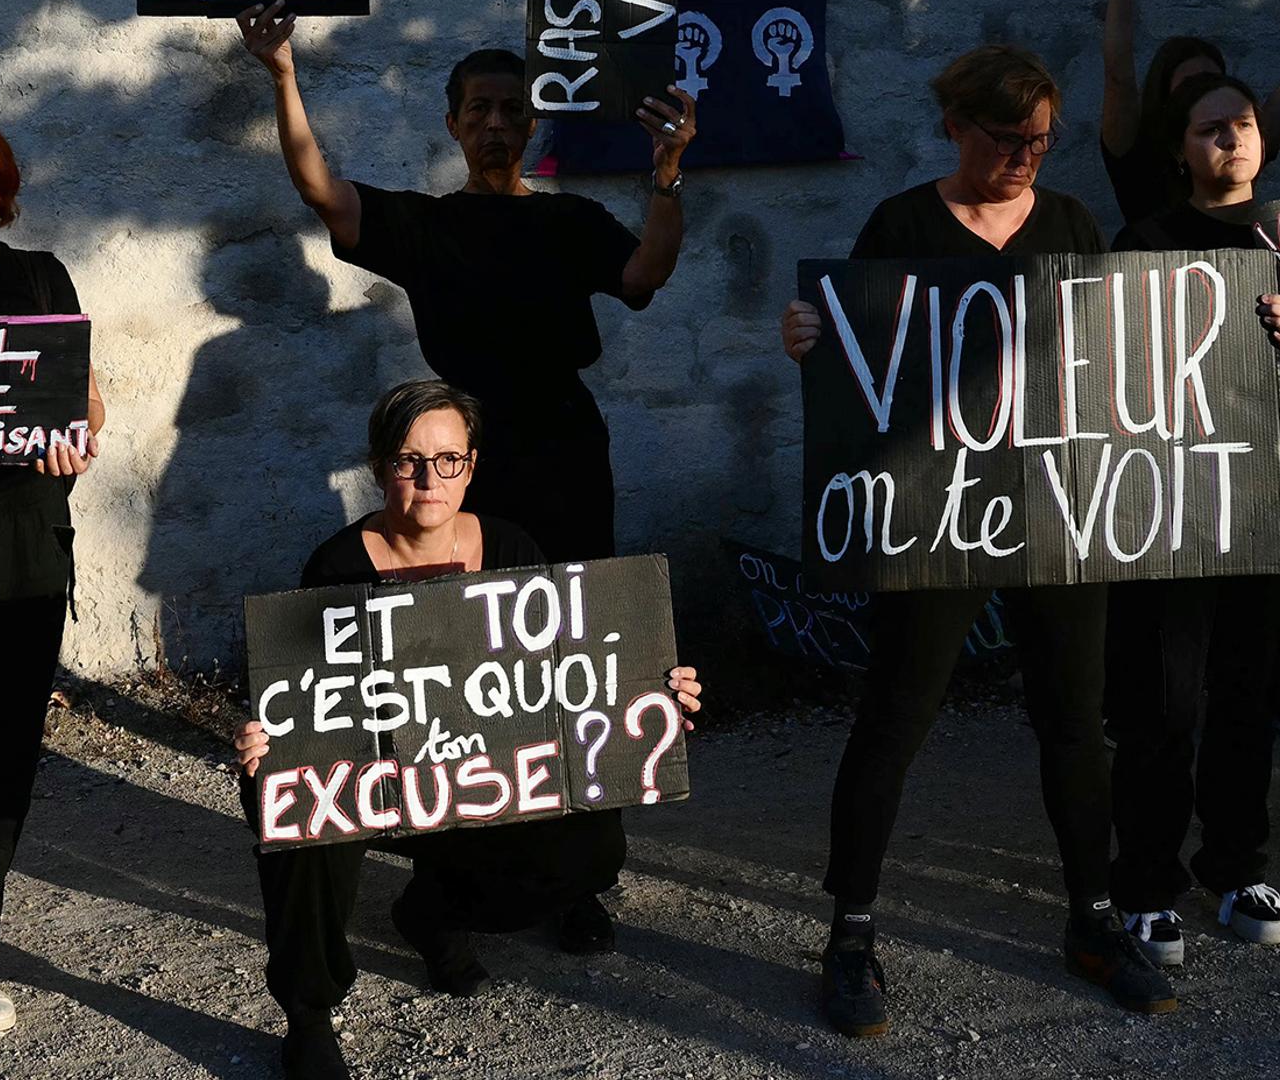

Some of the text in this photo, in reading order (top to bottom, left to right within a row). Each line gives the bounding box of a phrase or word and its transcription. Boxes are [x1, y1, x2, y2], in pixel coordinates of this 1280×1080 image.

[819, 261, 1226, 453] VIOLEUR
[817, 469, 917, 562] on
[930, 447, 1025, 557] te
[1042, 443, 1254, 562] VOIT
[322, 564, 587, 664] ET TOI
[258, 632, 621, 737] C'EST QUOI
[414, 718, 486, 763] ton
